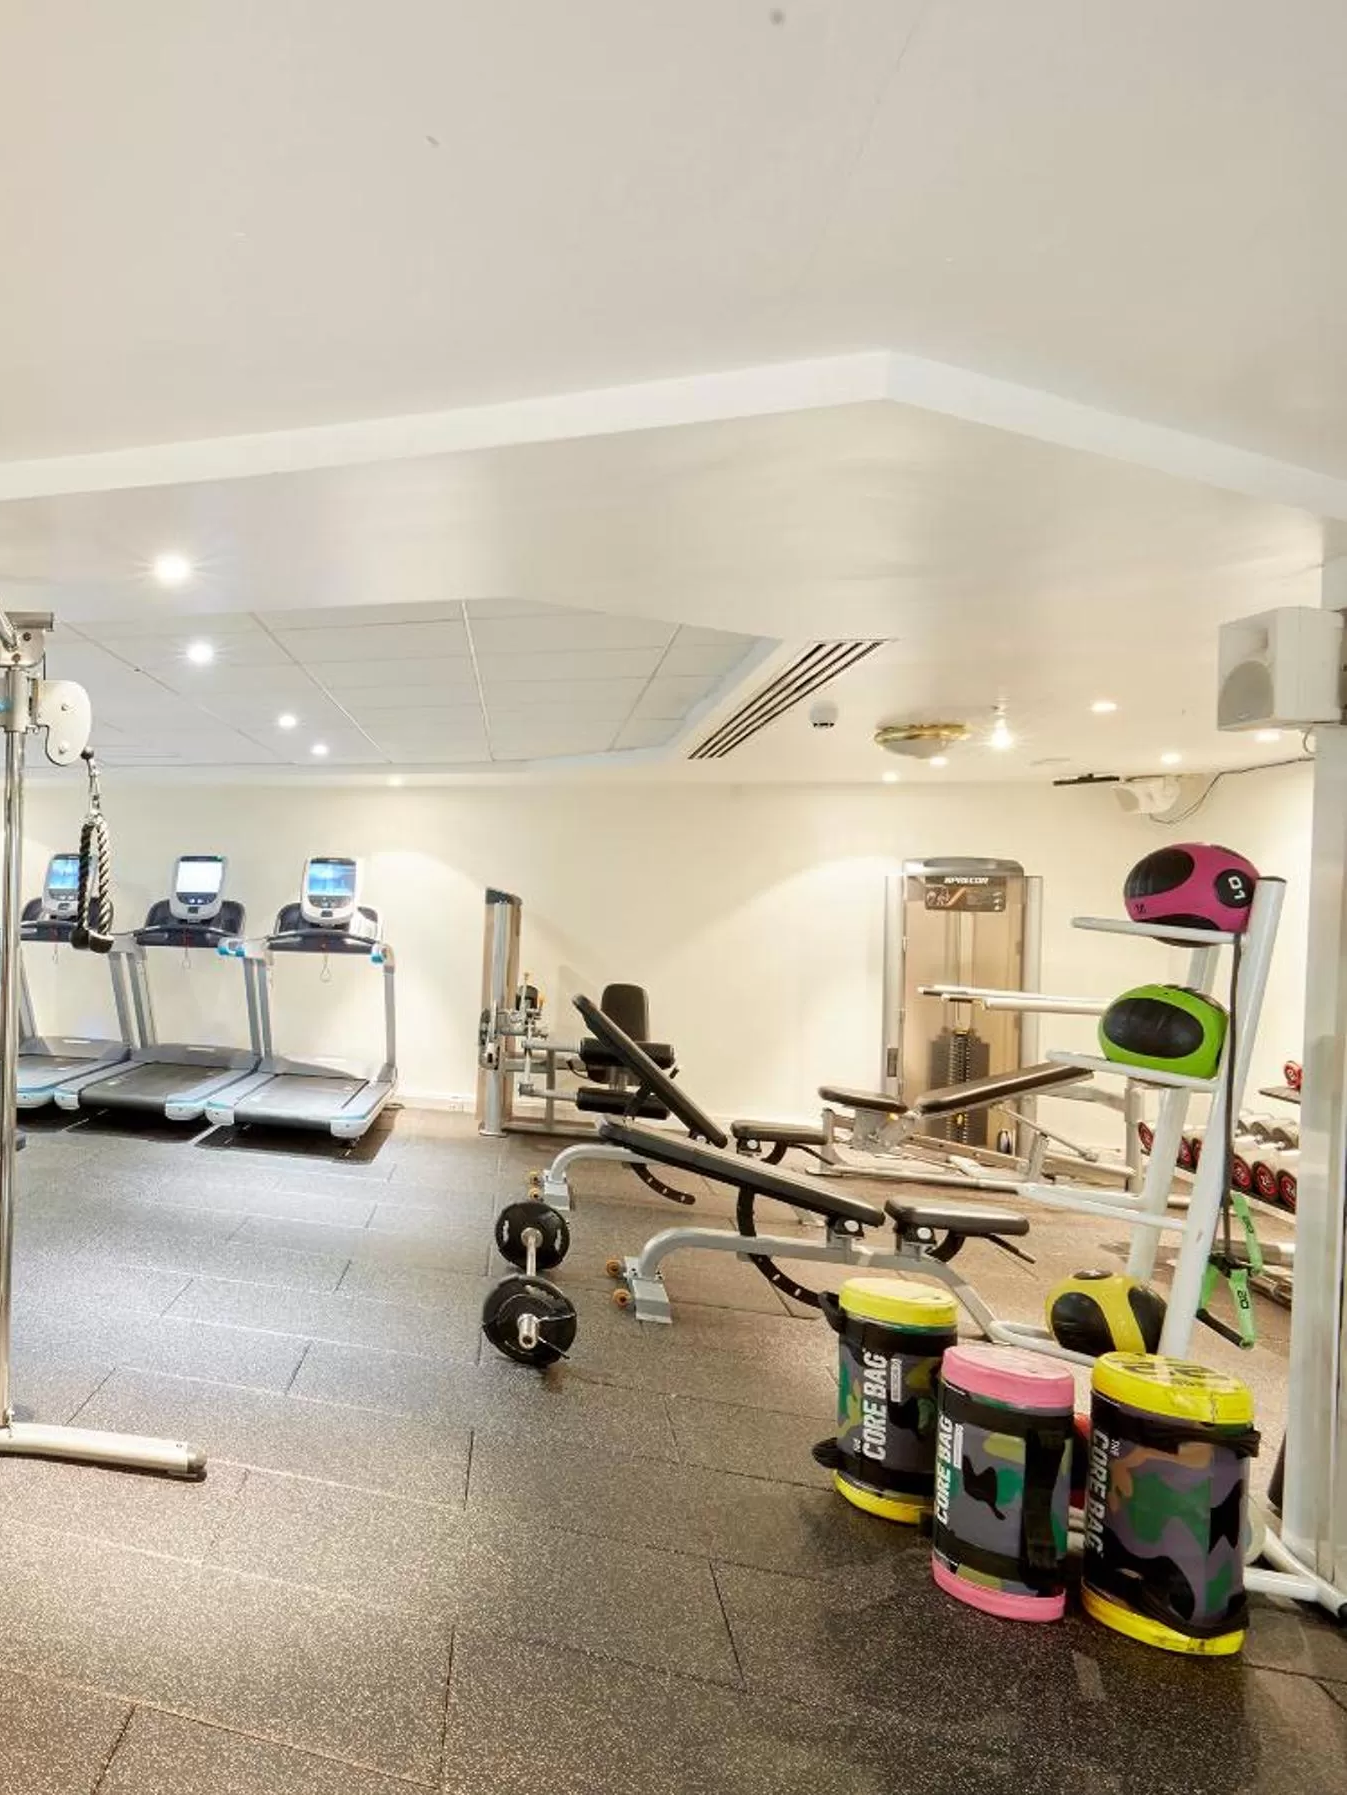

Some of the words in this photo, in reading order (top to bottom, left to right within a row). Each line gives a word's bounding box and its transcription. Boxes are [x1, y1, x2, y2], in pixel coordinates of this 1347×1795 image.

[1227, 876, 1247, 900] 01
[862, 1350, 888, 1400] BAG
[862, 1399, 888, 1461] CORE
[938, 1412, 954, 1464] BAG
[936, 1462, 952, 1525] CORE
